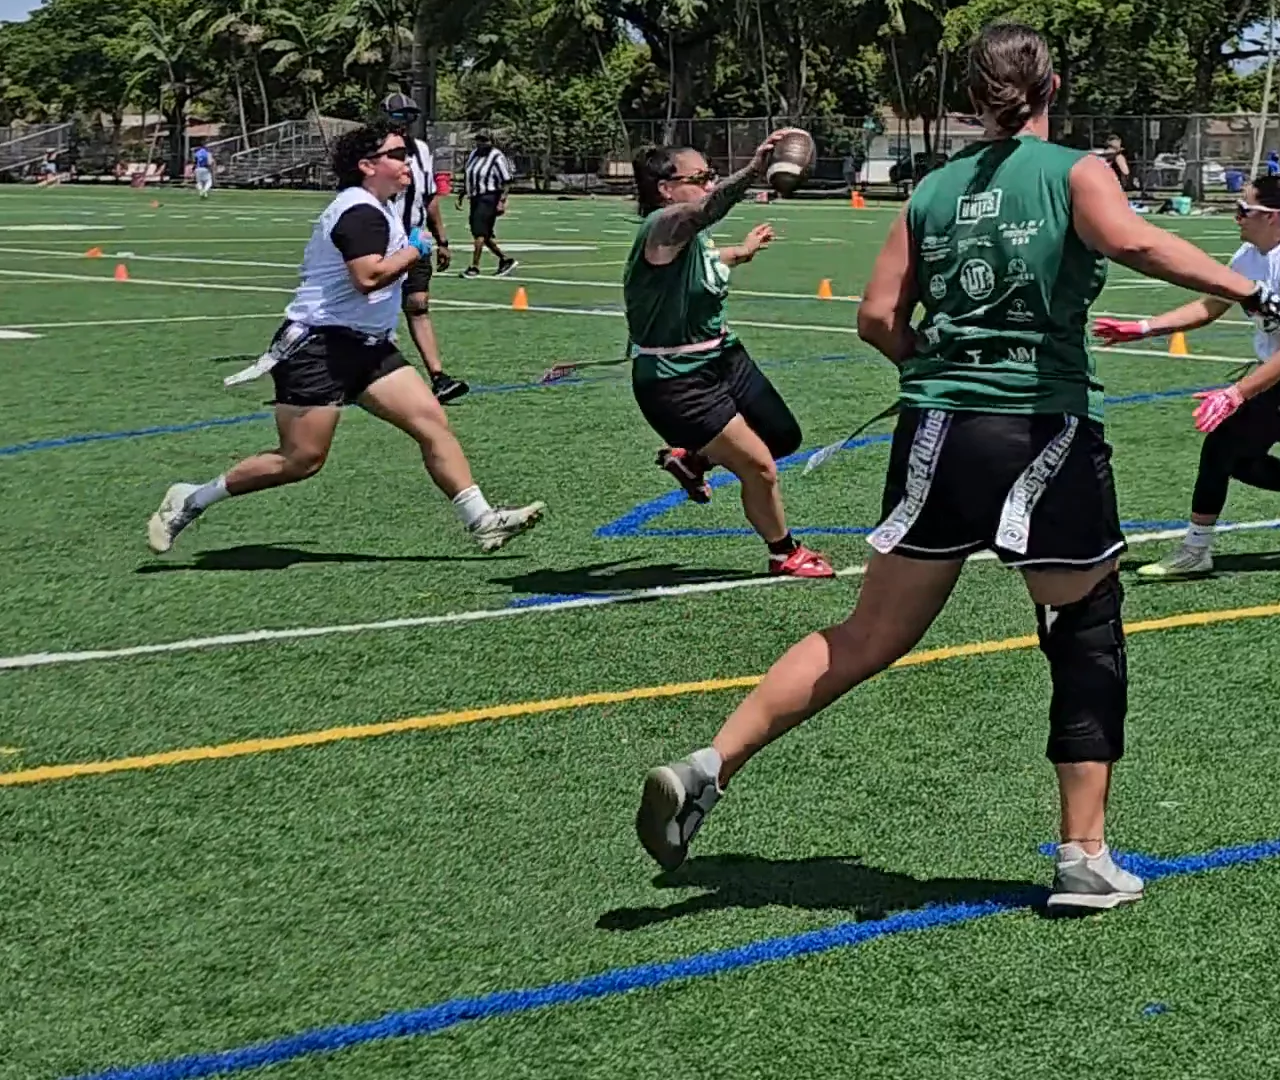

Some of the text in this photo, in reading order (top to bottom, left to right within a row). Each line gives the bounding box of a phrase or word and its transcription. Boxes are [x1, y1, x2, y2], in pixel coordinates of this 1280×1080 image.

[893, 408, 946, 527] SOUTH FLORIDA
[1006, 416, 1079, 523] SOUTH FLORIDA
